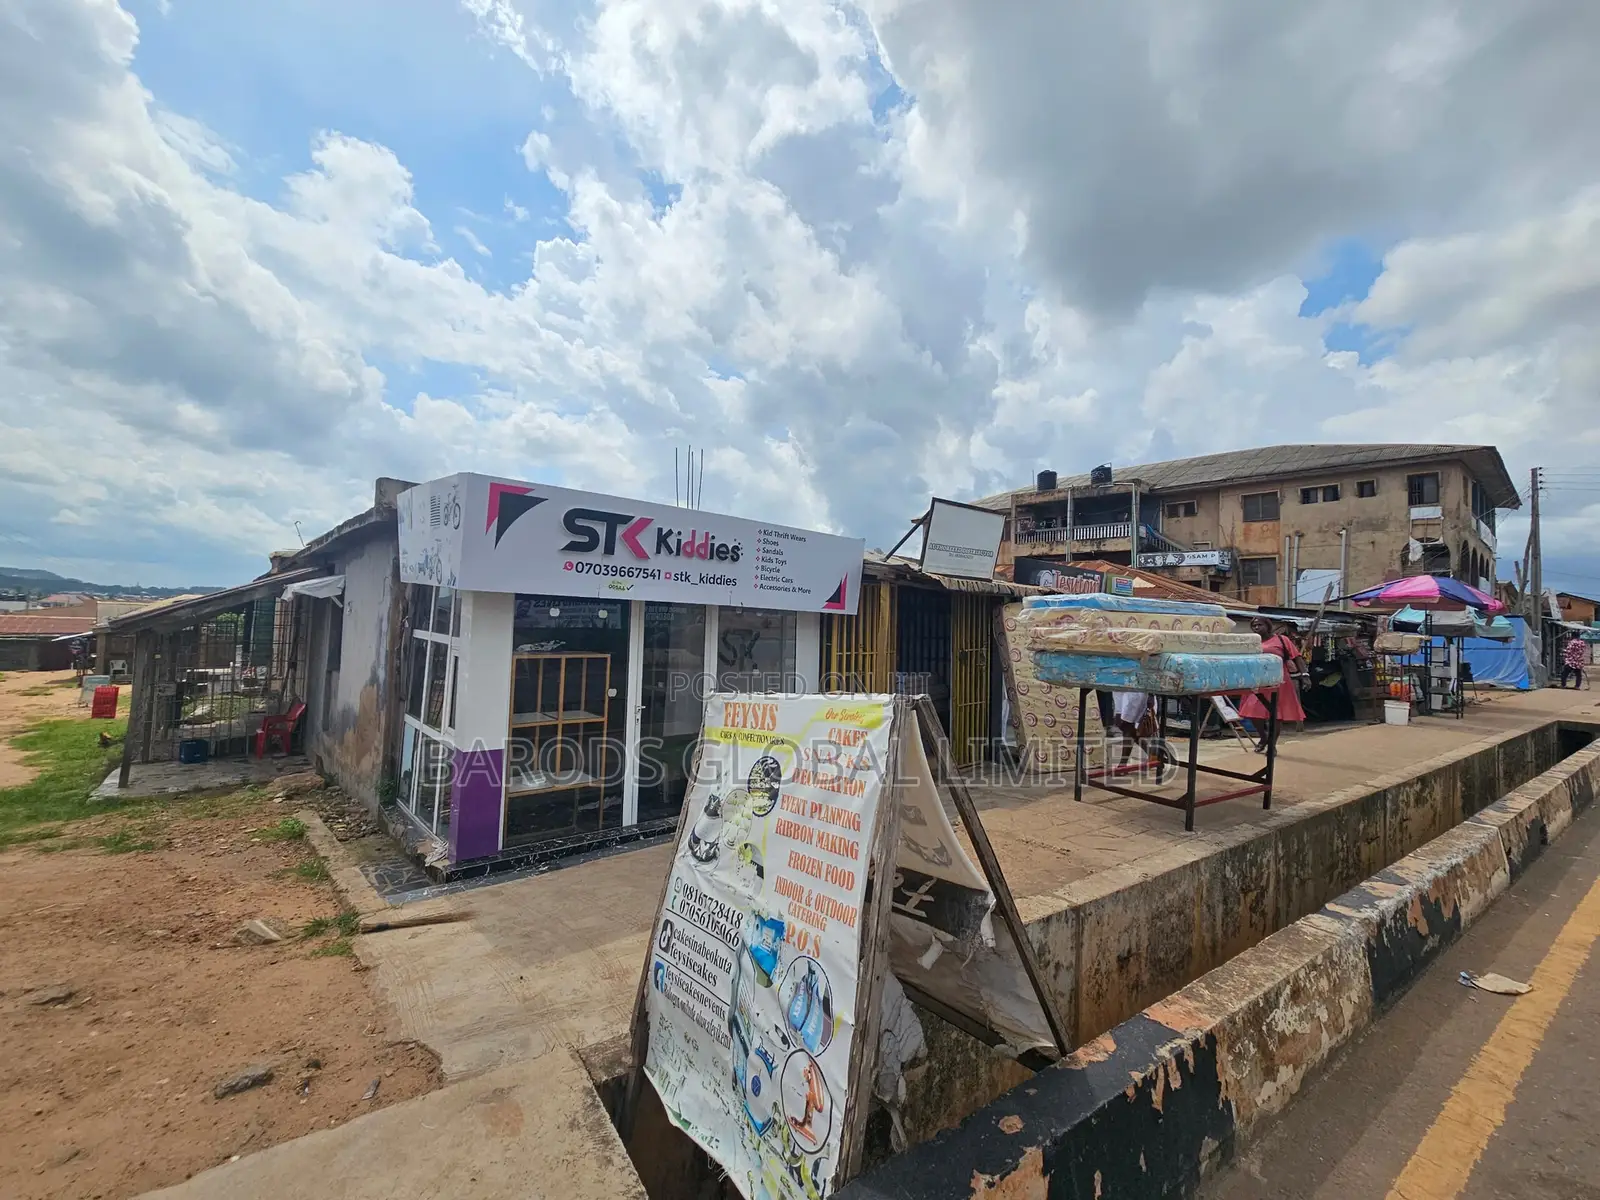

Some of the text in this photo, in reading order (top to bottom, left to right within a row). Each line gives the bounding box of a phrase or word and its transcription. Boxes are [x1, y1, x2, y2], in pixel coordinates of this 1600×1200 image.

[560, 508, 742, 562] STK Kiddies
[763, 538, 779, 546] Shoes
[774, 531, 789, 540] Thrift
[790, 534, 807, 542] Wears
[761, 556, 787, 566] Kids Toys
[762, 547, 784, 556] Sandals
[575, 561, 737, 587] 07039667541 stk_kiddies
[760, 574, 793, 584] Electric Cars
[761, 565, 780, 573] Bicycle
[760, 583, 790, 592] Accessories
[723, 702, 779, 731] FEYSIS
[829, 728, 868, 747] CAKES
[803, 748, 871, 771] SNACKS
[791, 768, 867, 798] DECORATION
[780, 794, 861, 832] EVENT PLANNING
[775, 818, 859, 861] RIBBON MAKING
[788, 849, 855, 891] FROZEN FOOD
[683, 883, 743, 929] 08167728418
[774, 875, 857, 928] INDOOR & OUTDOOR
[788, 901, 827, 932] CATERING
[673, 928, 732, 975] cakesinabeokuta
[785, 921, 822, 959] P.O.S
[670, 942, 718, 987] feysiscakes
[665, 965, 726, 1021] feysiscakesnevents
